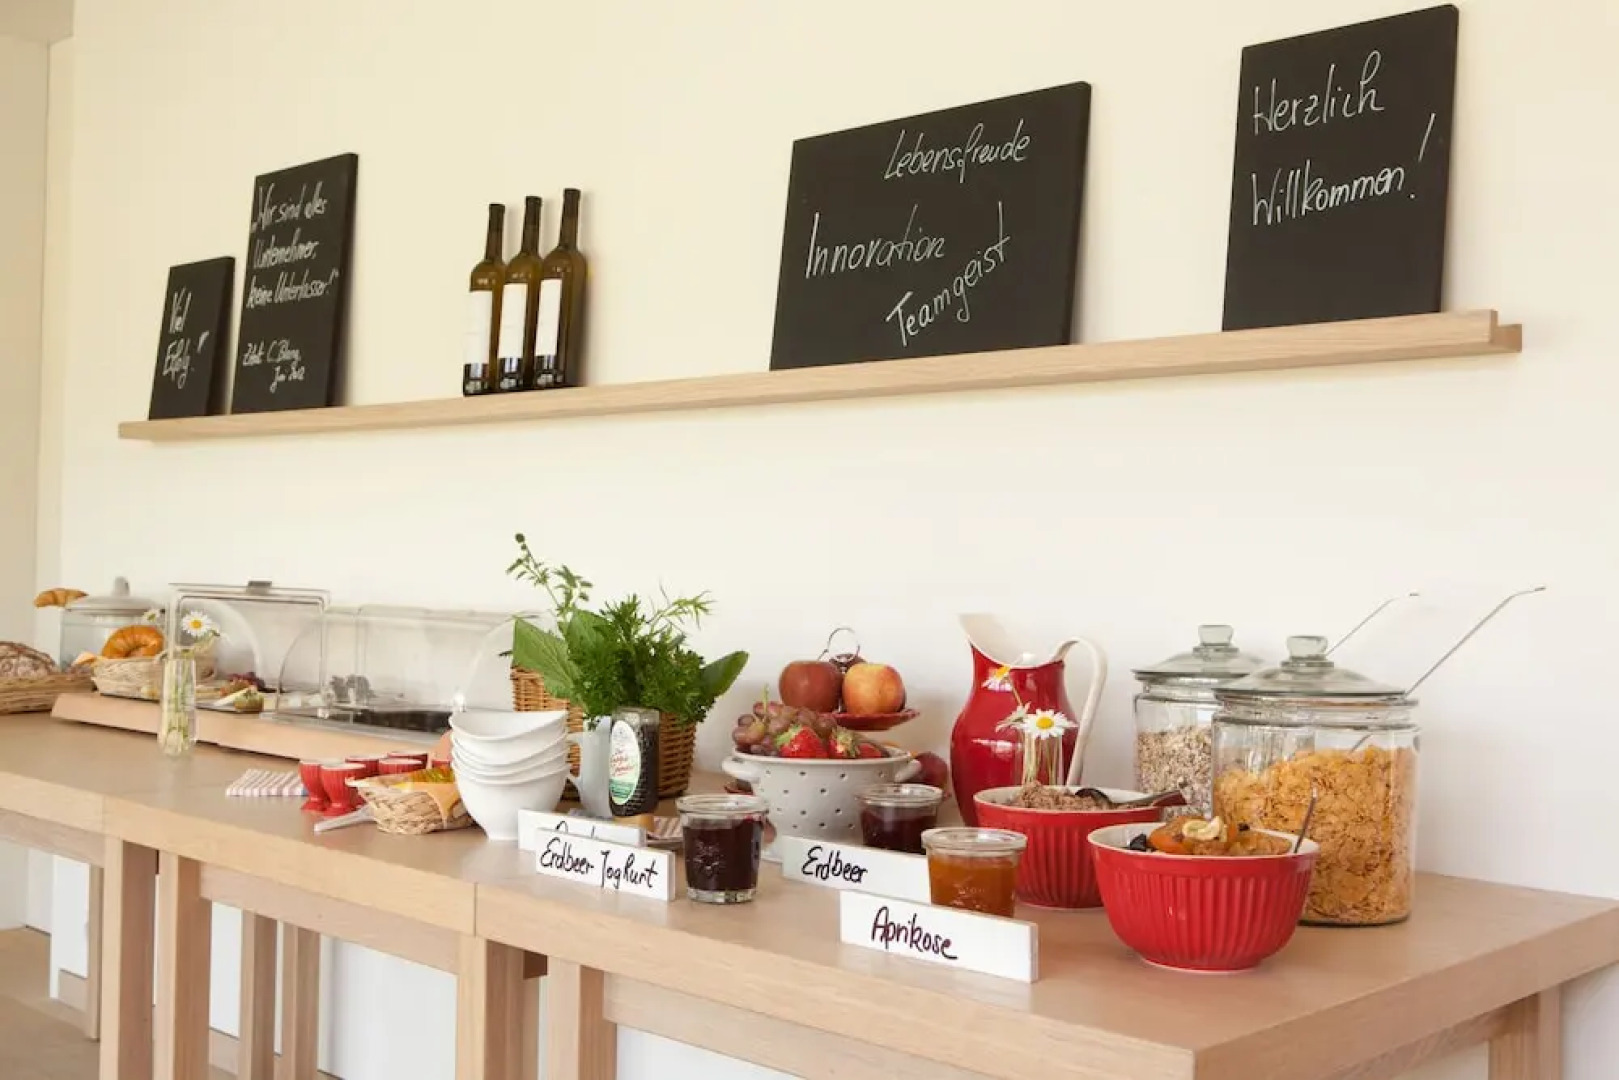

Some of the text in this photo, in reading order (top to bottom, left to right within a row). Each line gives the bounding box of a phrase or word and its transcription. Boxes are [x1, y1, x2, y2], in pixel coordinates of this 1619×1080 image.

[1253, 50, 1385, 136] Herzlich
[884, 118, 1031, 183] Lebensfreude
[805, 203, 945, 279] Innovation
[884, 200, 1010, 347] Teamgeist
[540, 836, 659, 890] Erdbeer Joghurt
[801, 846, 868, 883] Erdbeer
[871, 906, 958, 960] Aprikose
